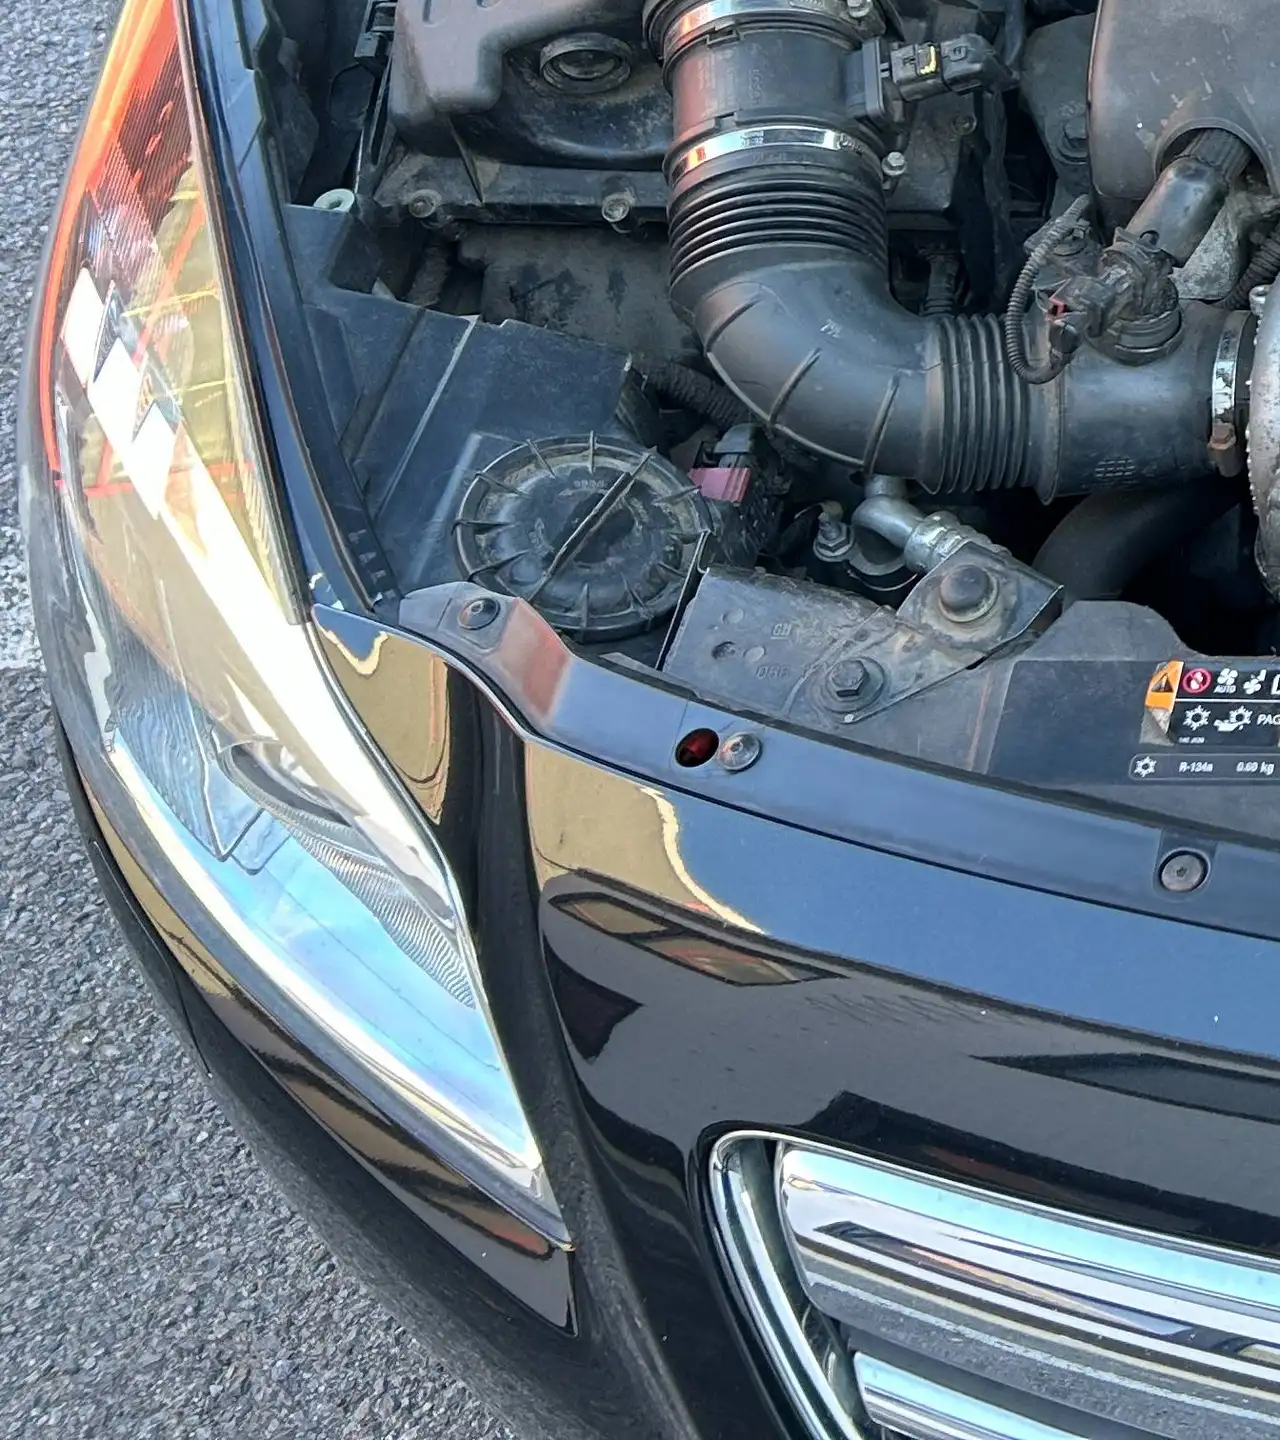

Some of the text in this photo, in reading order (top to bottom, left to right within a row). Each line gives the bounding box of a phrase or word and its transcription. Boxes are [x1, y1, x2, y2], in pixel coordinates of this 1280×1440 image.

[1213, 685, 1237, 694] AUTO
[1178, 761, 1214, 773] R-134a
[1260, 761, 1275, 776] kg
